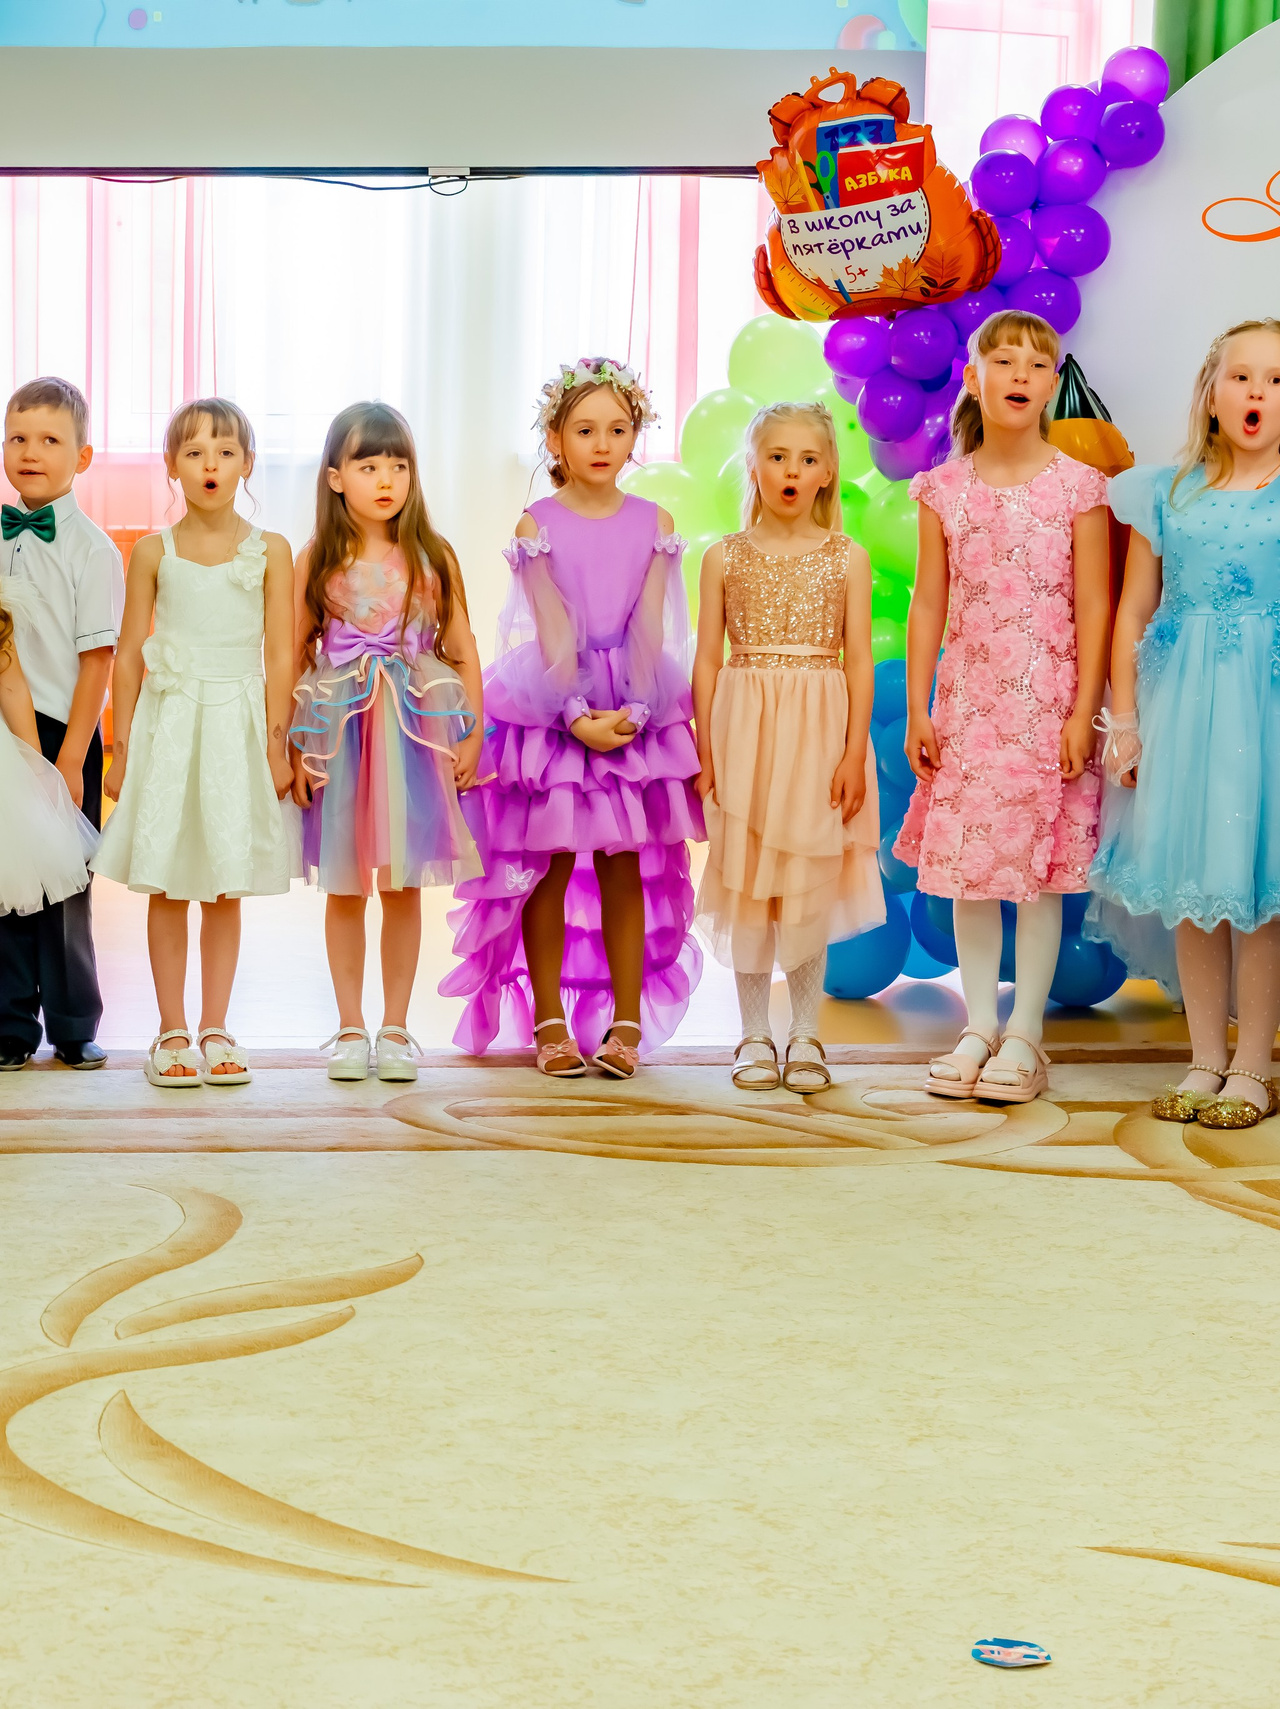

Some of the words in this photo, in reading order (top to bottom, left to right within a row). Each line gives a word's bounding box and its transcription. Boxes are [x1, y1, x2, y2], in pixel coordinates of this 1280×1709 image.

[824, 121, 884, 152] 123
[844, 166, 913, 192] АЗБУКА
[804, 209, 882, 233] школу
[886, 198, 916, 217] за
[792, 221, 923, 260] пятёрками
[845, 265, 869, 283] 5+
